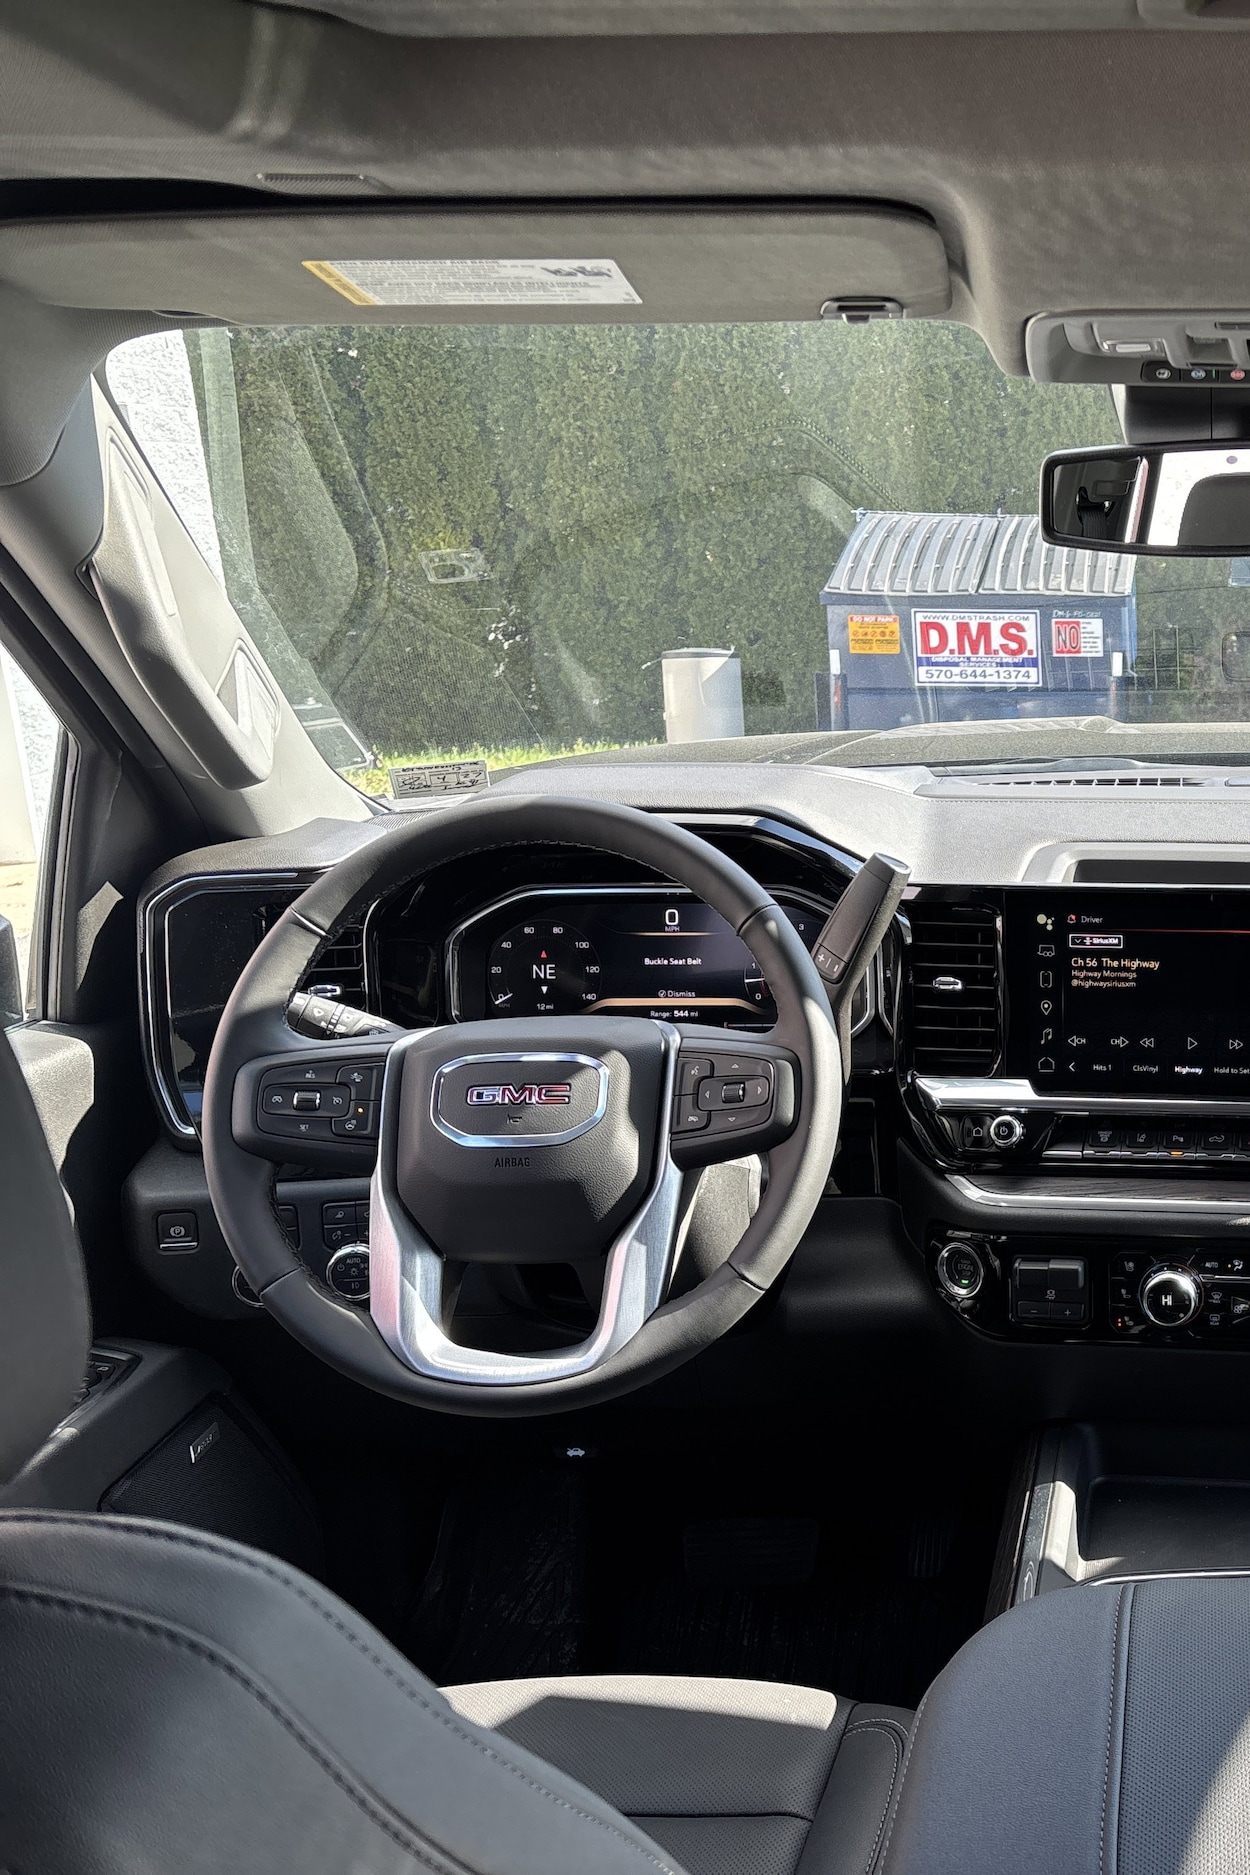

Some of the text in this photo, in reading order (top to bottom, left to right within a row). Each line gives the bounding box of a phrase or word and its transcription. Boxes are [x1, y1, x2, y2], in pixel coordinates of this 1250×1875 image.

[920, 621, 1034, 656] D.M.S.
[1056, 625, 1079, 650] NO
[925, 669, 1032, 681] 570-644-1374
[665, 909, 679, 926] 0
[1081, 915, 1103, 924] Driver
[1071, 958, 1160, 970] Ch 56 The Highway
[491, 966, 502, 974] 20
[532, 964, 556, 979] NE
[1072, 970, 1137, 979] Highway Mornings
[1071, 979, 1137, 988] @highwaysiriusxm
[1133, 1065, 1159, 1074] ClsVinyl
[1174, 1066, 1203, 1075] Highway
[467, 1084, 571, 1106] GMC
[494, 1158, 530, 1167] AIRBAG
